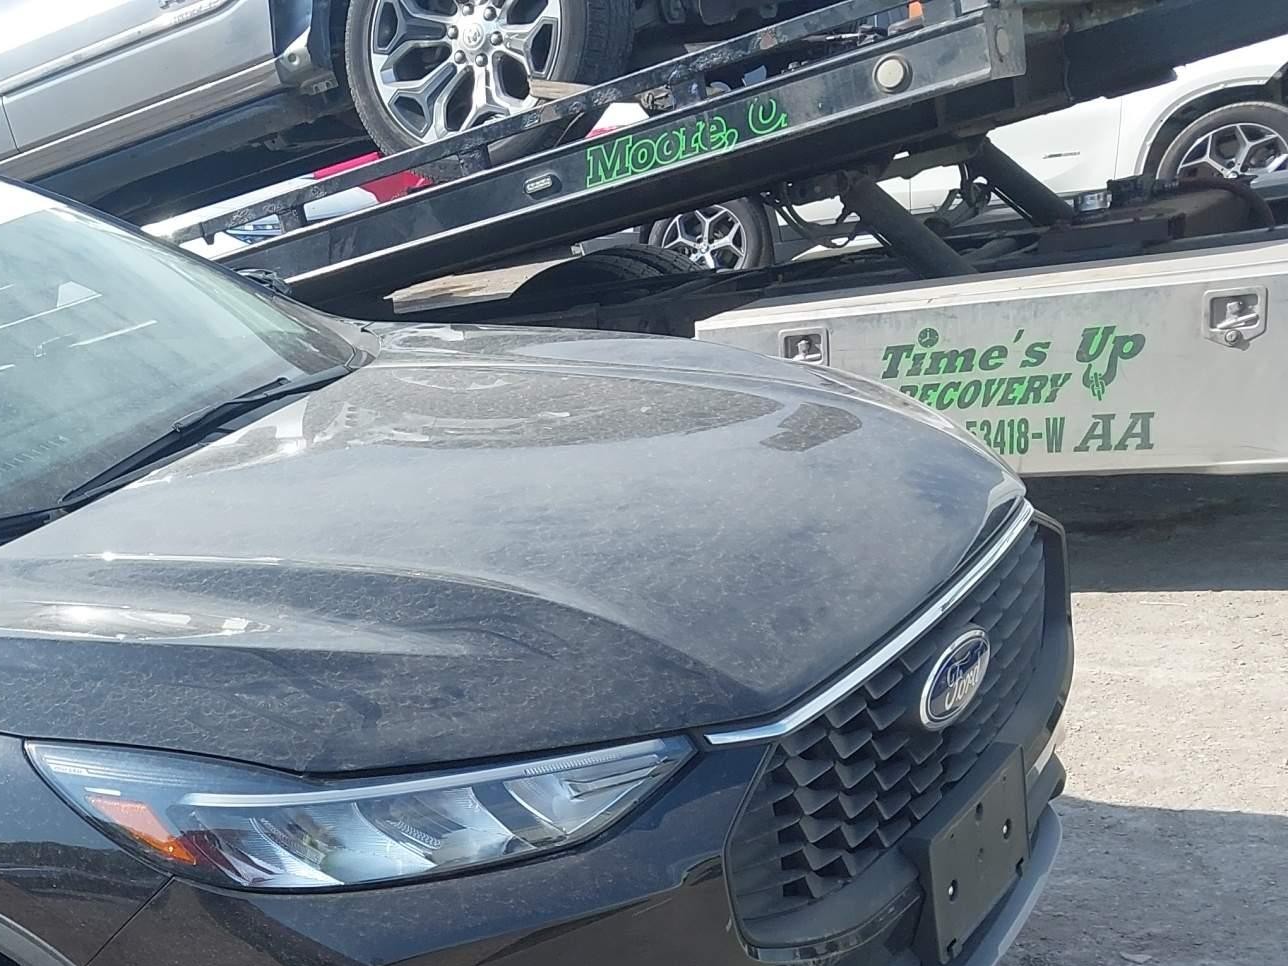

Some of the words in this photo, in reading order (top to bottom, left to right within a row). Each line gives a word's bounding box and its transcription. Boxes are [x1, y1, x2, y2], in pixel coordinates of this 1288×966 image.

[881, 327, 1051, 379] Time's
[1076, 325, 1146, 400] Up
[1073, 412, 1155, 452] AA
